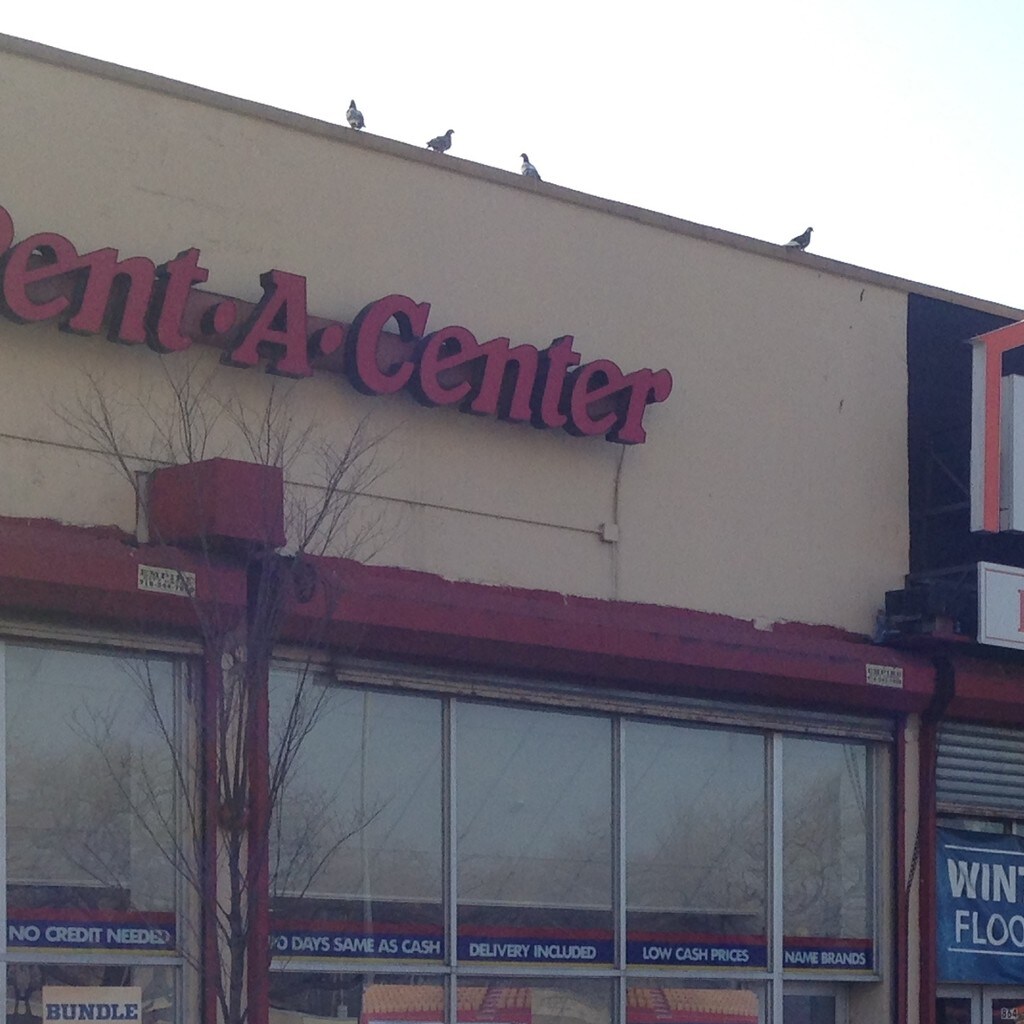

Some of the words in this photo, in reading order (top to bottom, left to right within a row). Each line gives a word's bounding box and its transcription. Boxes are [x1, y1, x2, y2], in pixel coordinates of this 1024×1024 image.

[8, 924, 40, 943] NO
[45, 926, 103, 944] CREDIT
[106, 928, 171, 945] NEEDED
[292, 936, 331, 952] DAYS
[334, 937, 375, 954] SAME
[378, 938, 398, 954] AS
[401, 939, 441, 955] CASH
[469, 942, 530, 959] DELIVERY
[533, 944, 597, 960] INCLUDED
[642, 947, 672, 961] LOW
[675, 947, 709, 962] CASH
[710, 949, 750, 963] PRICES
[785, 951, 819, 965] NAME
[821, 952, 866, 966] BRANDS
[46, 1003, 139, 1022] BUNDLE
